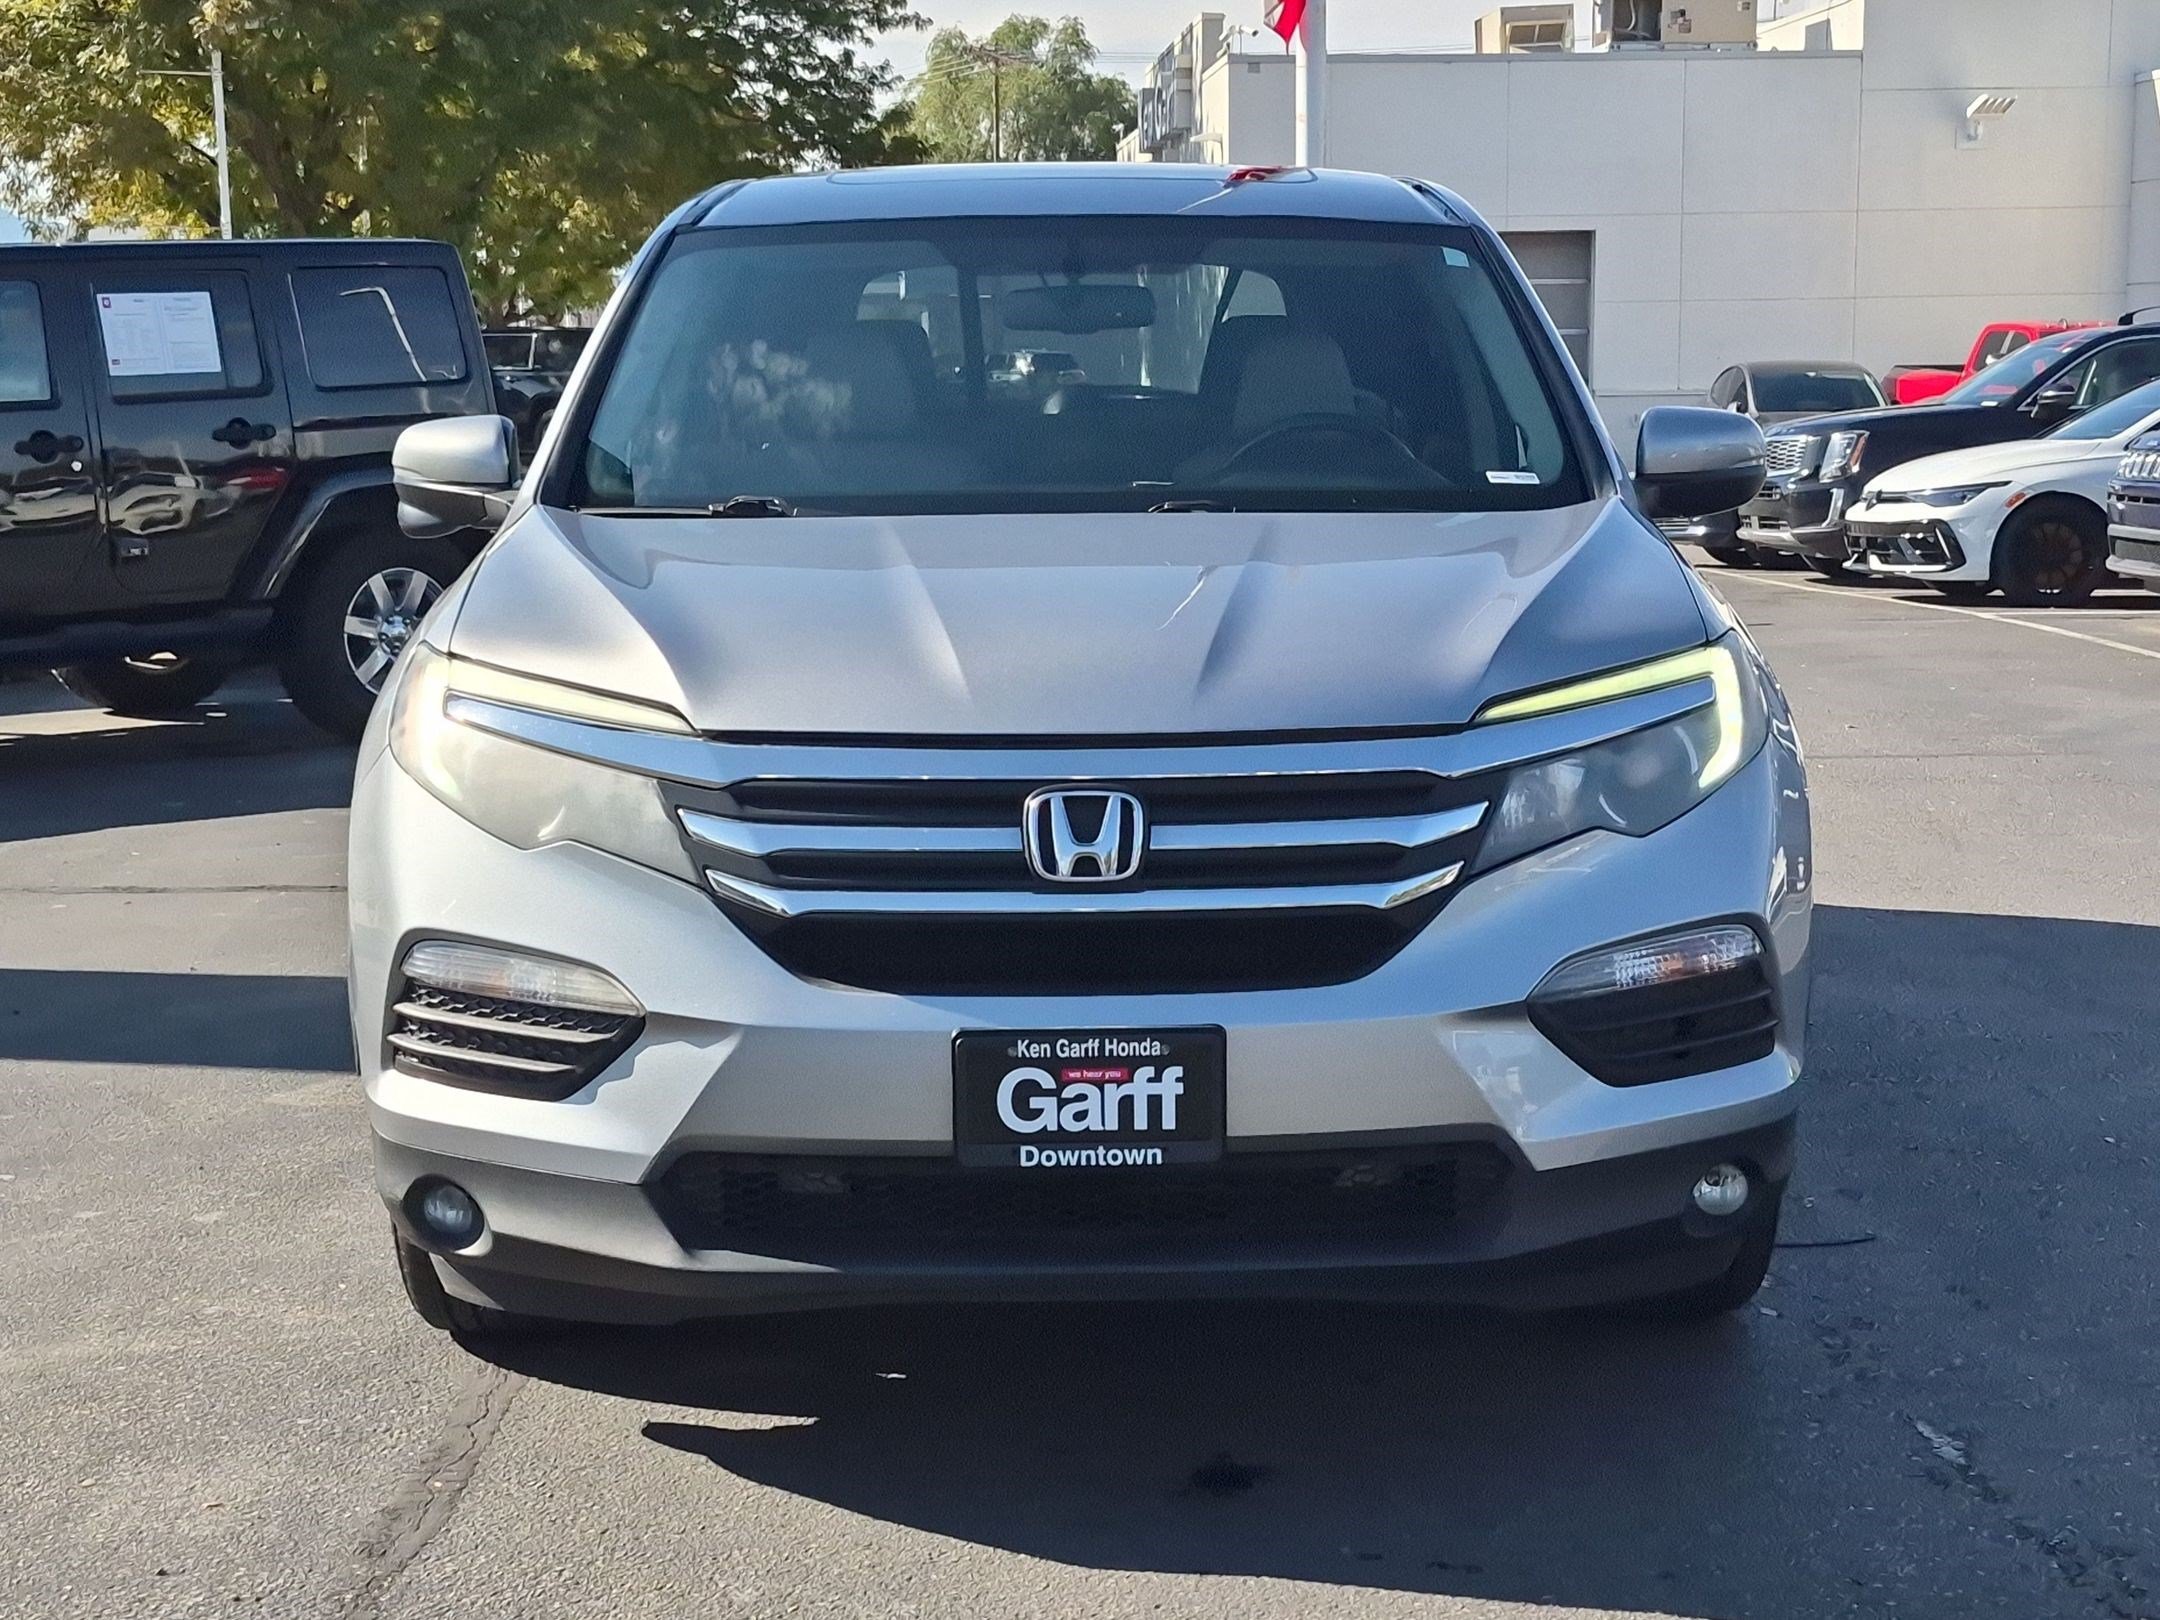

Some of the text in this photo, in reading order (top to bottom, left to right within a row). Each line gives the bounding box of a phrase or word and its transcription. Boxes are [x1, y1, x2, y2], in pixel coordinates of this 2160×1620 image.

[1017, 1037, 1162, 1058] Ken Garff Honda
[1083, 1069, 1103, 1078] hear
[1105, 1070, 1121, 1080] you
[997, 1066, 1184, 1133] Garff
[1020, 1145, 1162, 1167] Downtown
